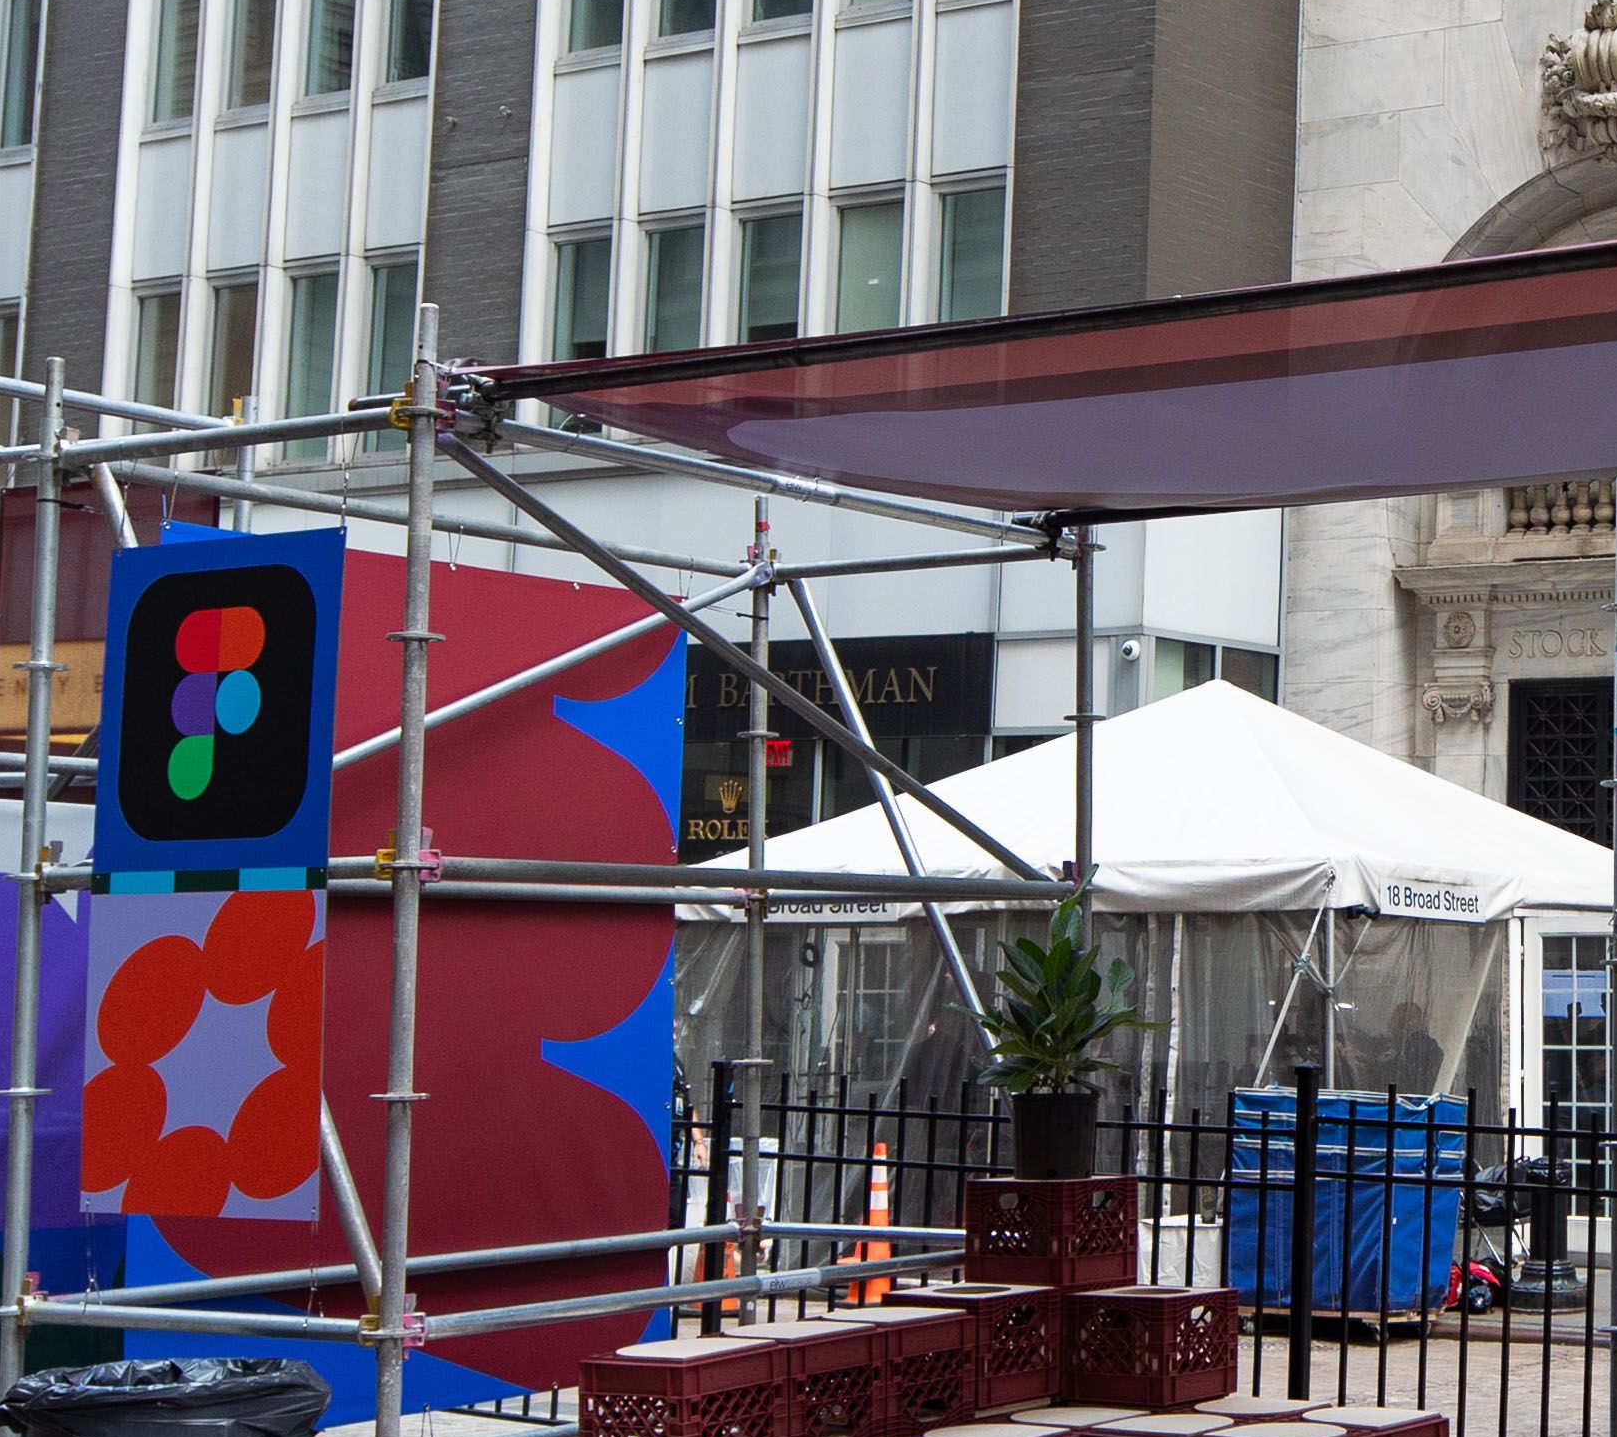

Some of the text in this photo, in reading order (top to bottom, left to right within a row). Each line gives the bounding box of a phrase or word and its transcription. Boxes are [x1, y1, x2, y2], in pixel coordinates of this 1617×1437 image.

[1508, 627, 1607, 659] STOCK
[766, 739, 792, 766] EXIT
[687, 819, 769, 840] ROLE
[1387, 885, 1479, 913] 18 Broad Street
